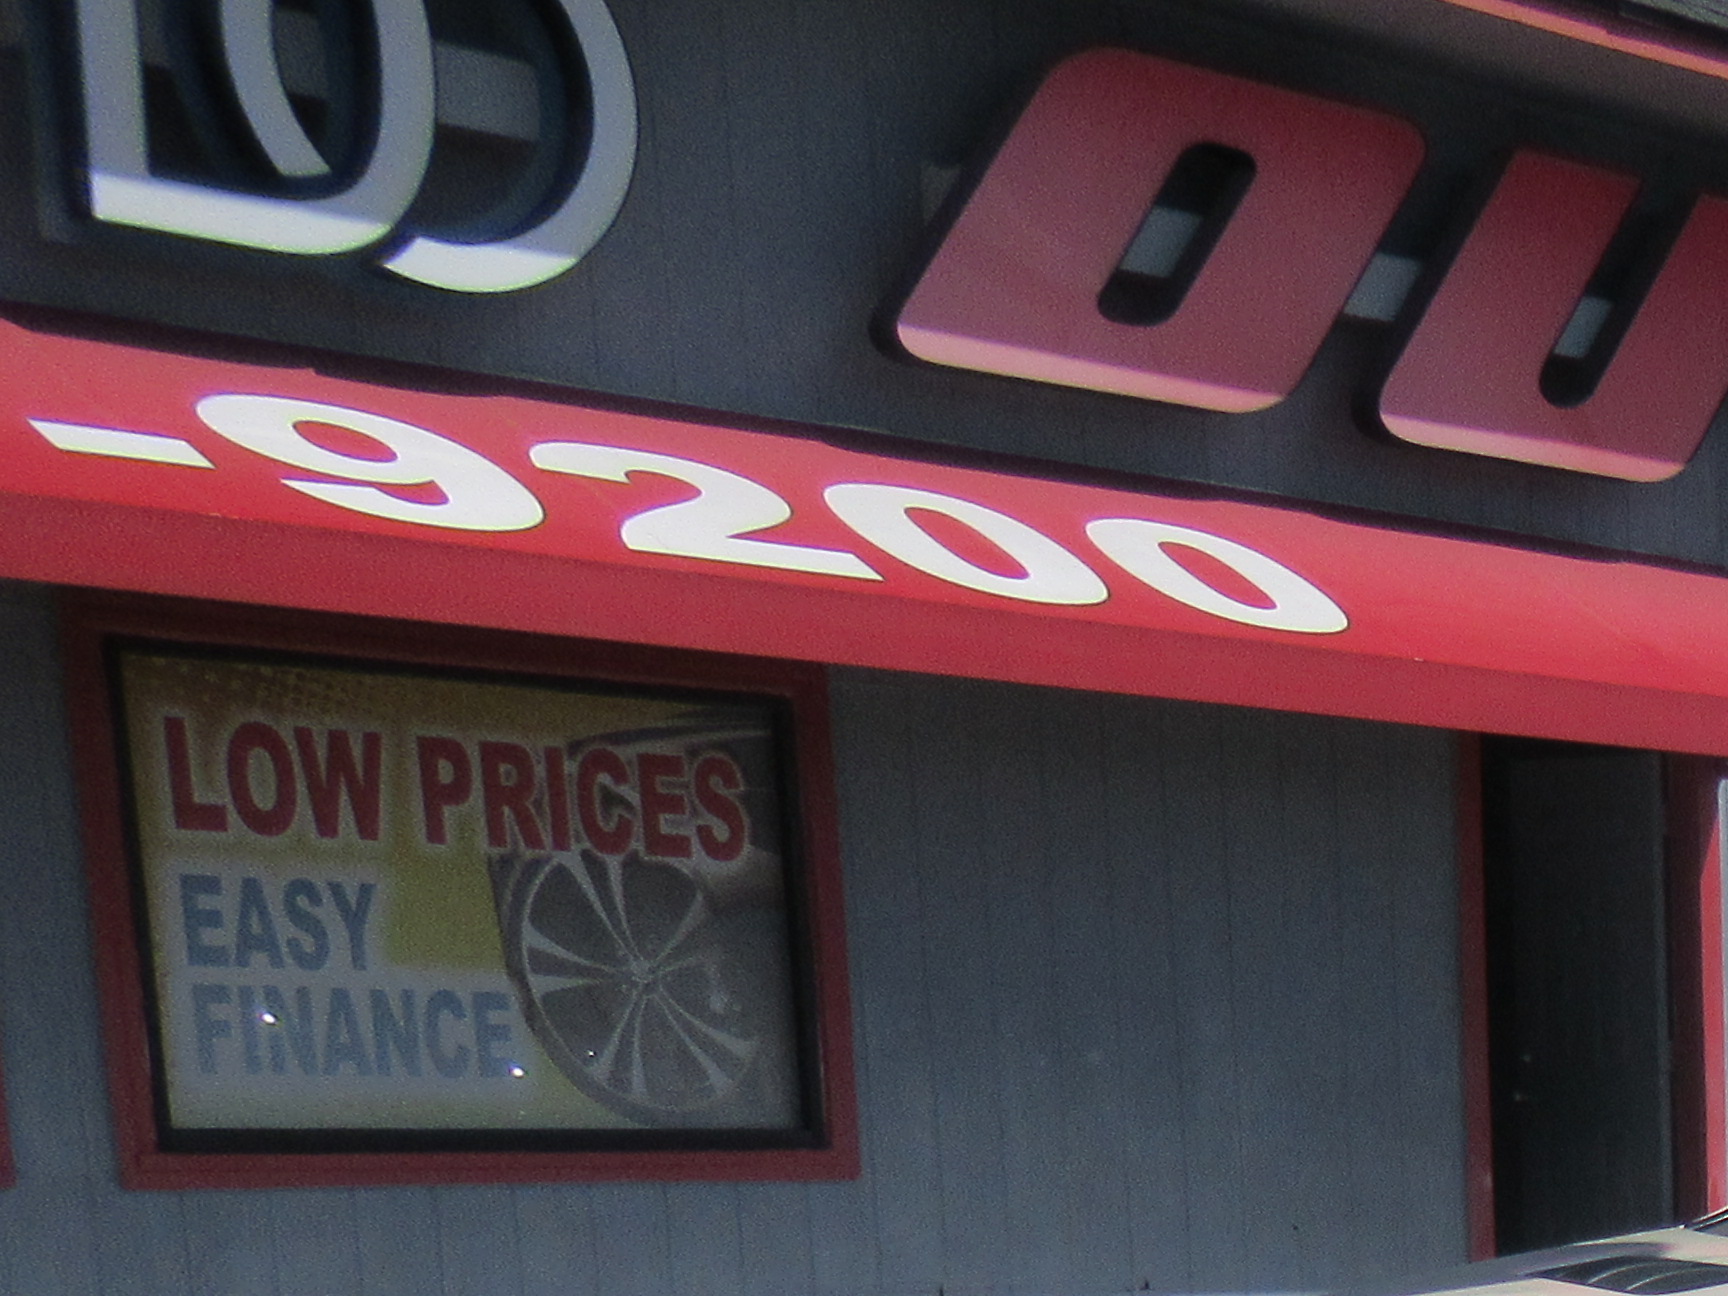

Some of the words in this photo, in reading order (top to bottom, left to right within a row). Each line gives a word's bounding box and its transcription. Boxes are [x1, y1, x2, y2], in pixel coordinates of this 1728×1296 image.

[163, 716, 383, 841] LOW
[416, 733, 752, 863] PRICES
[178, 872, 379, 973] EASY
[190, 981, 519, 1081] FINANCE
